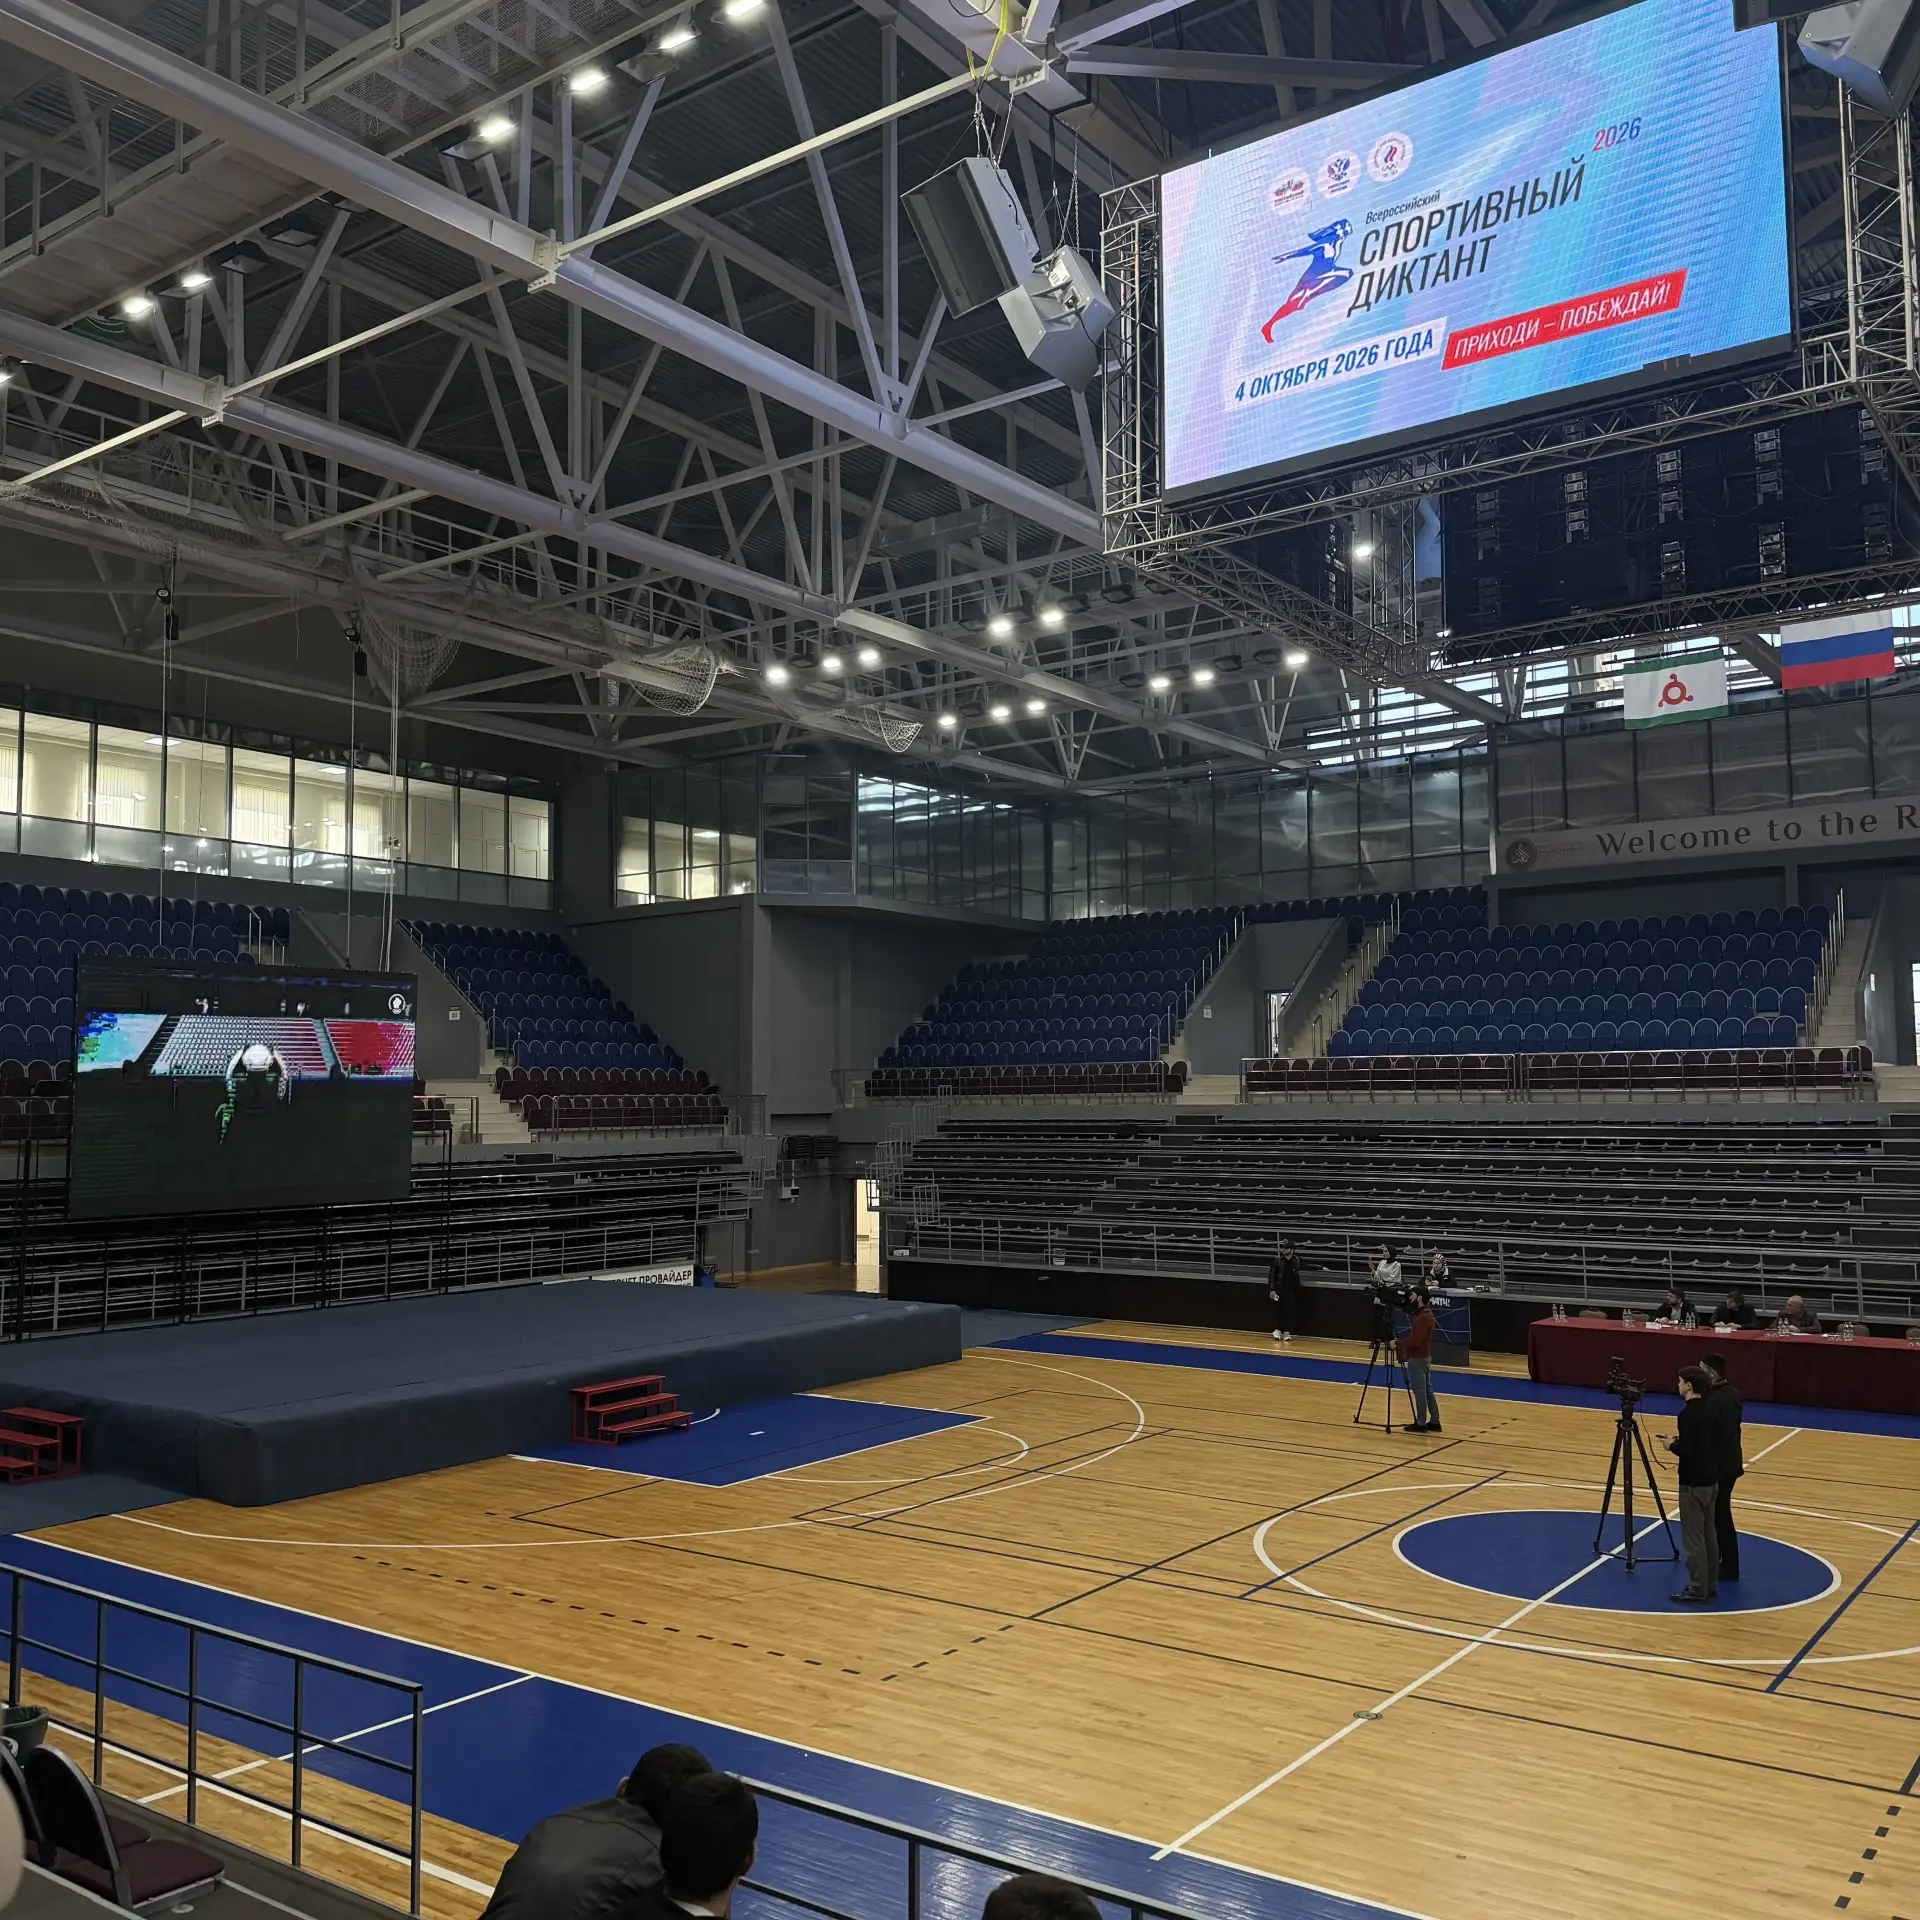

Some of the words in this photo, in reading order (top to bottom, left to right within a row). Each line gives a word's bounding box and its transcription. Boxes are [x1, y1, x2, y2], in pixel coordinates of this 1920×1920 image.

[1592, 117, 1642, 152] 2026
[1359, 153, 1586, 266] СПОРТИВНЫЙ
[1366, 189, 1441, 225] Всероссийский
[1347, 234, 1497, 317] ДИКТАНТ
[1454, 317, 1541, 360] ПРИХОДИ
[1559, 279, 1671, 332] ПОБЕЖДАЙ!
[1234, 382, 1246, 402] 4
[1250, 357, 1330, 399] ОКТЯБРЯ
[1333, 344, 1380, 375] 2026
[1384, 328, 1433, 360] ГОДА
[1595, 826, 1751, 857] Welcome
[1767, 818, 1802, 843] to
[1818, 811, 1878, 837] the
